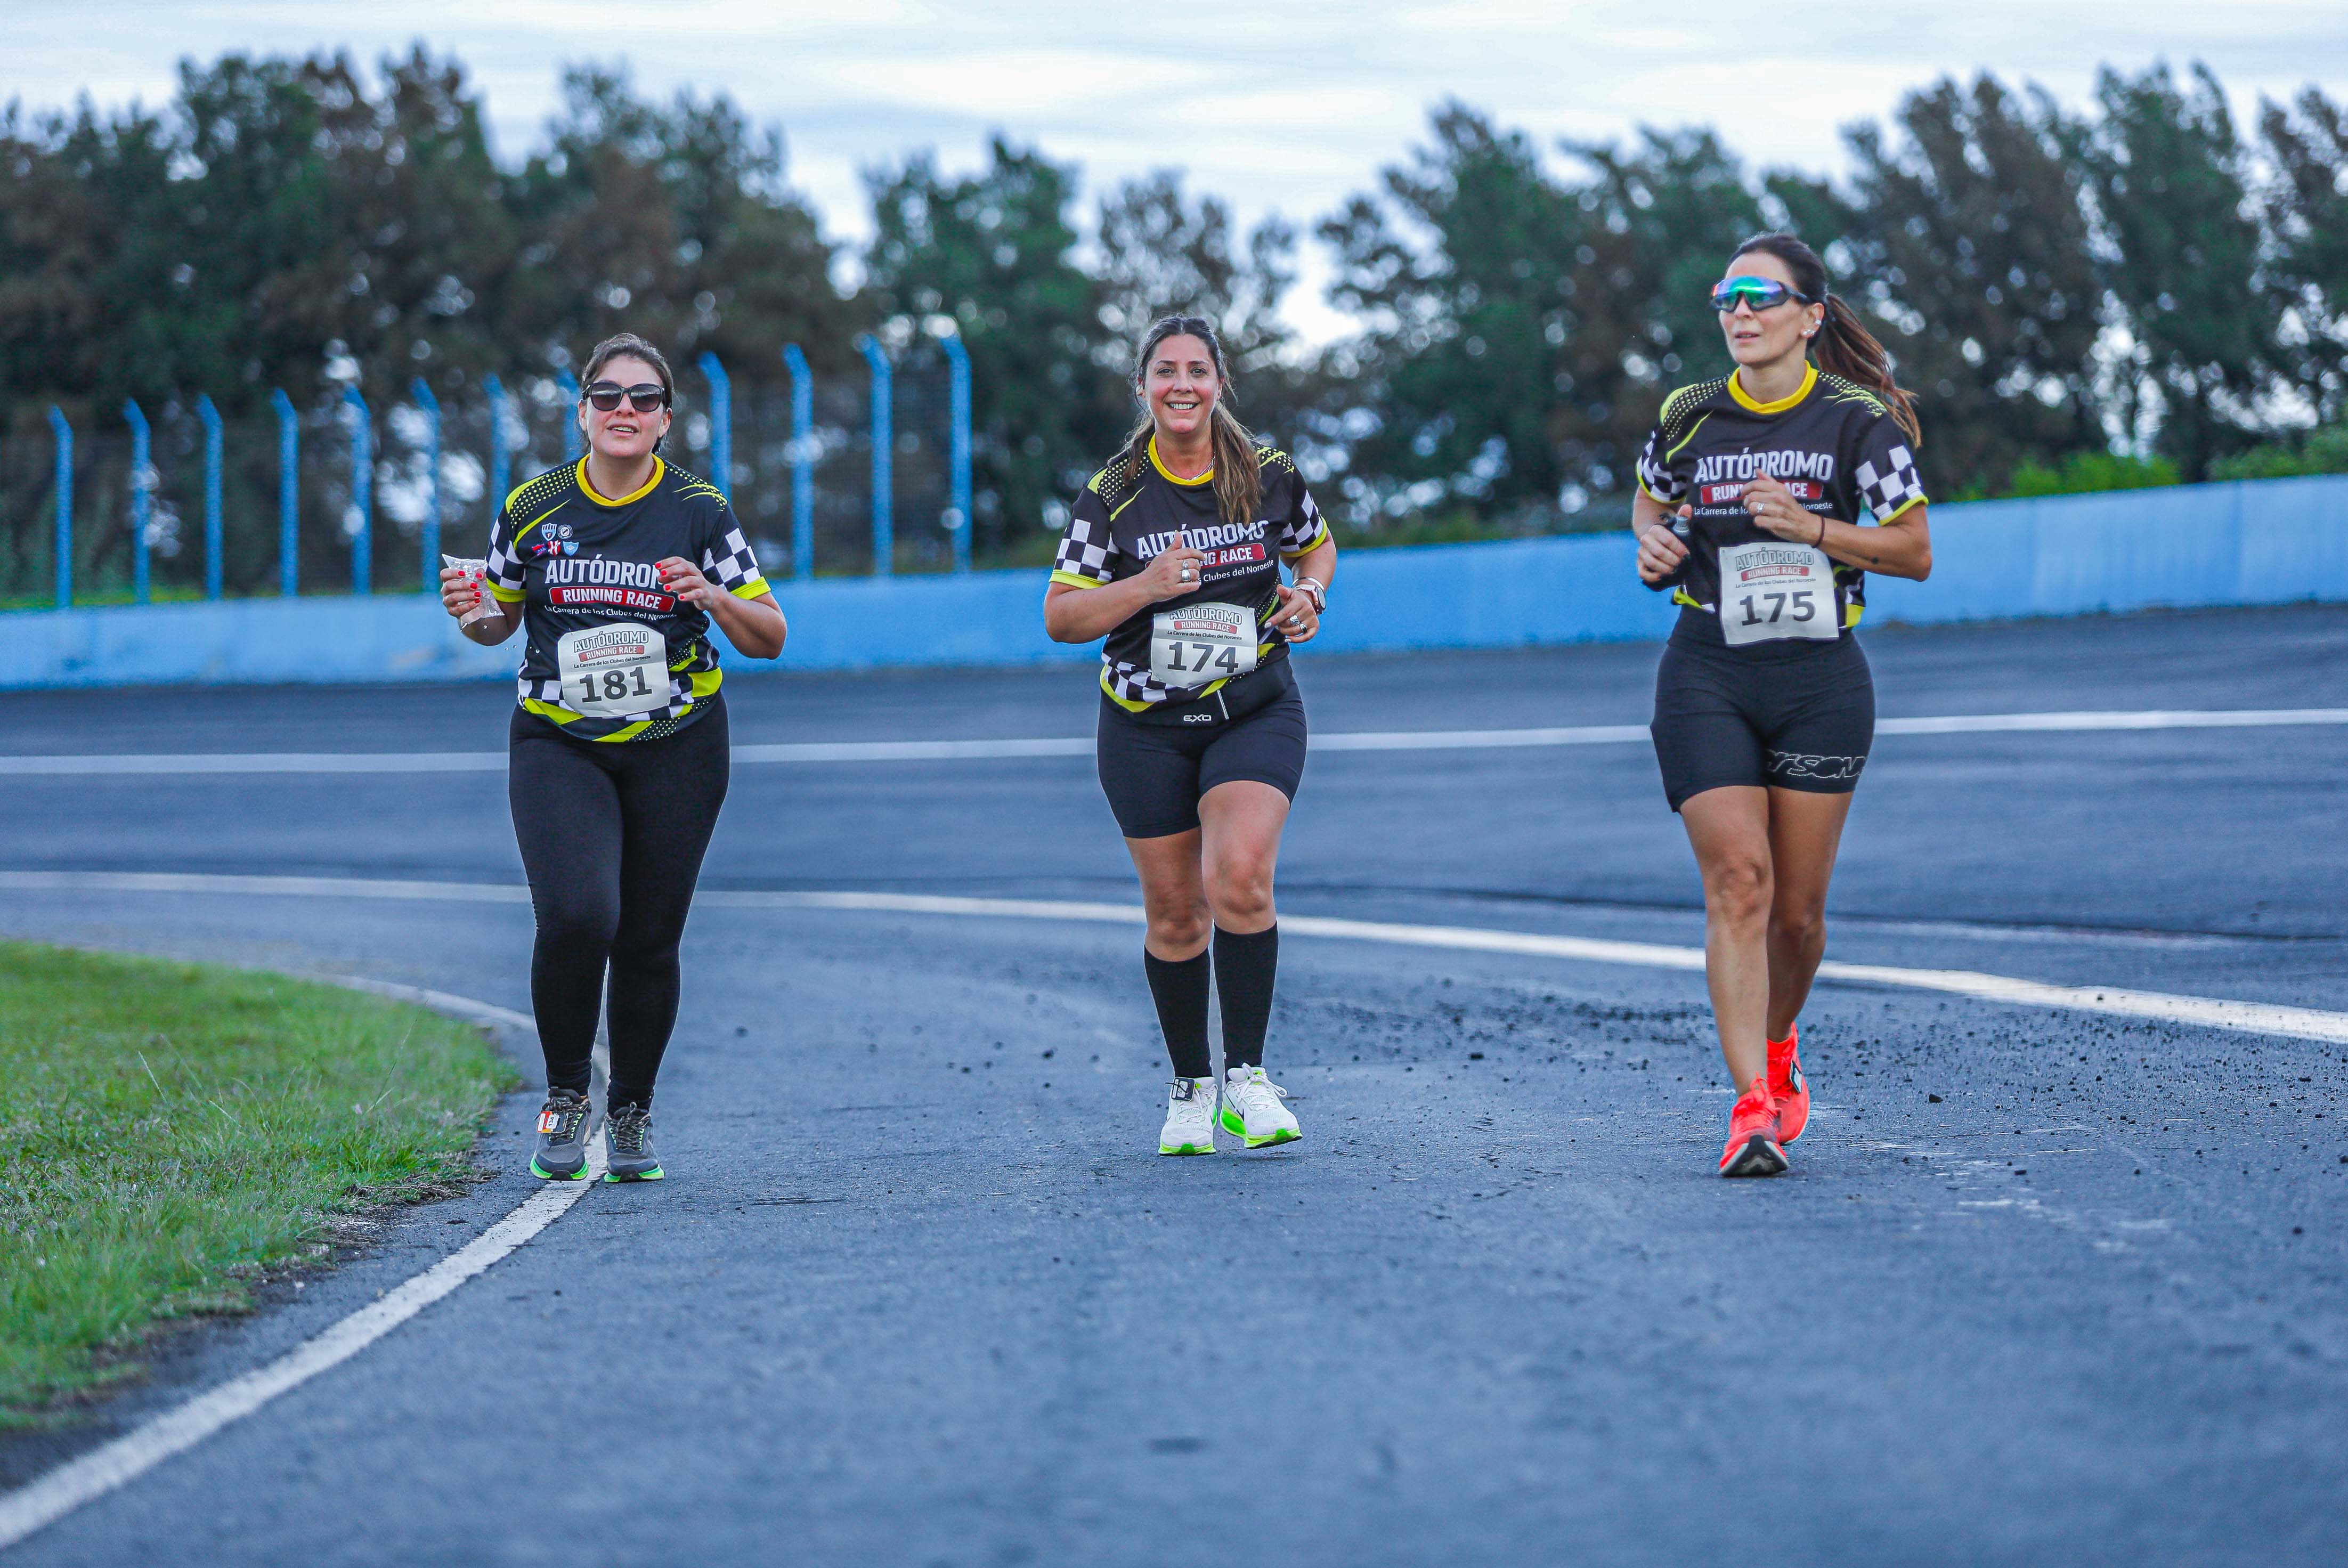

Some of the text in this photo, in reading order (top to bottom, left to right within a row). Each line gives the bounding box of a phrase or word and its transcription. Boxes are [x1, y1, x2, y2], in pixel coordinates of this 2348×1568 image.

[1694, 447, 1834, 484] AUTÓDROMO
[1785, 482, 1808, 497] CE
[1701, 507, 1727, 515] Carrera
[1729, 506, 1739, 515] de
[1220, 547, 1254, 564] RACE
[1735, 547, 1815, 571] AUTÓDROMO
[545, 554, 666, 589] AUTÓDRO
[1203, 571, 1231, 582] Clubes
[1232, 566, 1245, 576] del
[1247, 559, 1274, 574] Noroeste
[1747, 566, 1801, 579] RUNNING RACE
[562, 588, 662, 610] RUNNING RACE
[1740, 590, 1816, 626] 175
[553, 605, 580, 614] Carrera
[606, 608, 632, 617] Clubes
[1169, 605, 1242, 625] AUTÓDROMO
[1181, 621, 1231, 632] RUNNING RACE
[574, 631, 649, 653] AUTÓDROMO
[586, 646, 637, 660] RUNNING RACE
[1167, 641, 1239, 674] 174
[579, 666, 653, 703] 181
[1183, 714, 1212, 722] EXO
